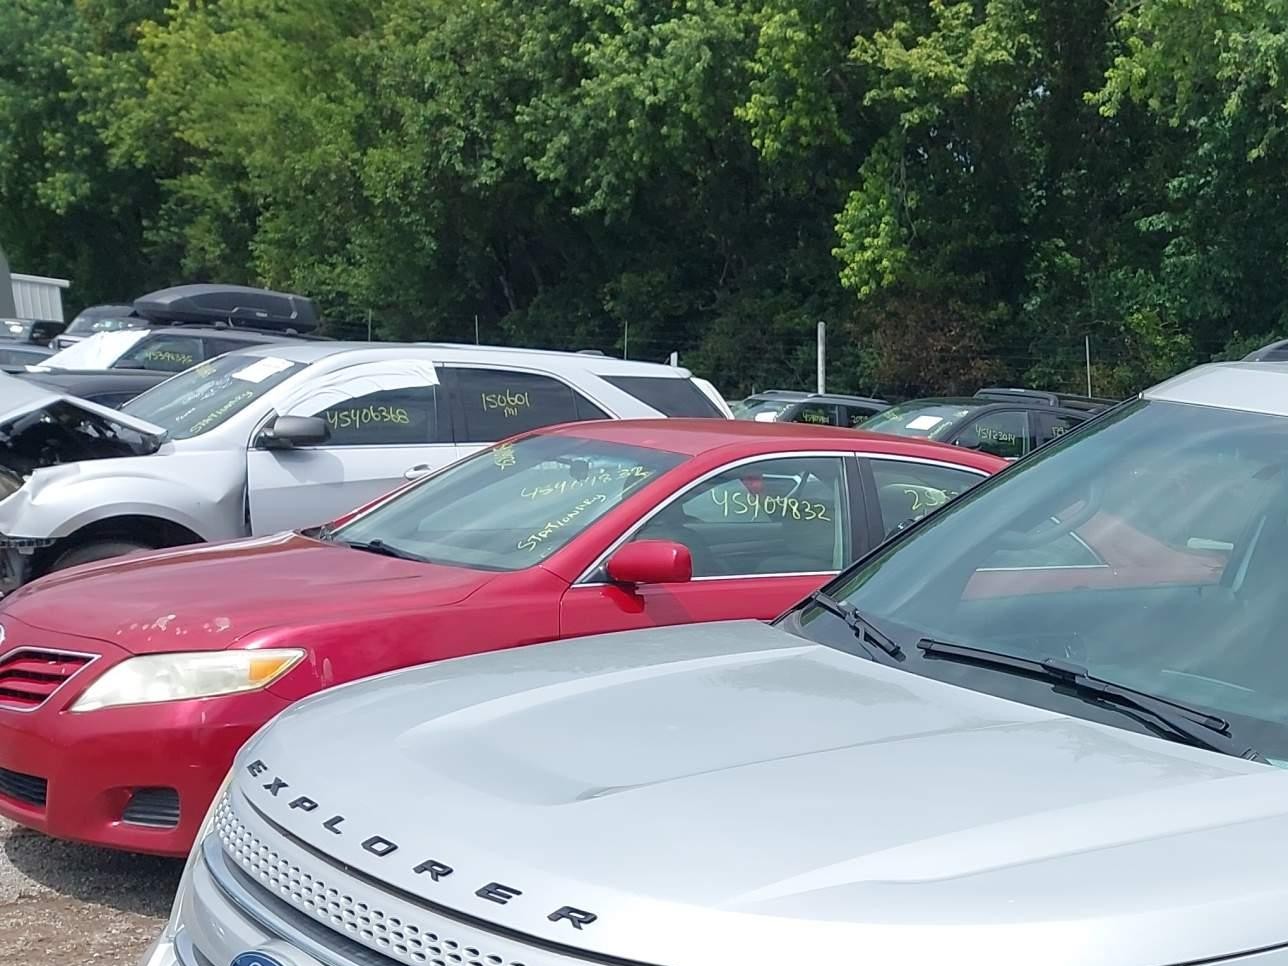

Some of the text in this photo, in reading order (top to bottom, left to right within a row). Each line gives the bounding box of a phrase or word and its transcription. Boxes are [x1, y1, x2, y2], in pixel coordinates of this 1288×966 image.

[481, 388, 531, 412] 150601
[326, 405, 410, 430] 45406368
[246, 759, 599, 931] EXPLORER
